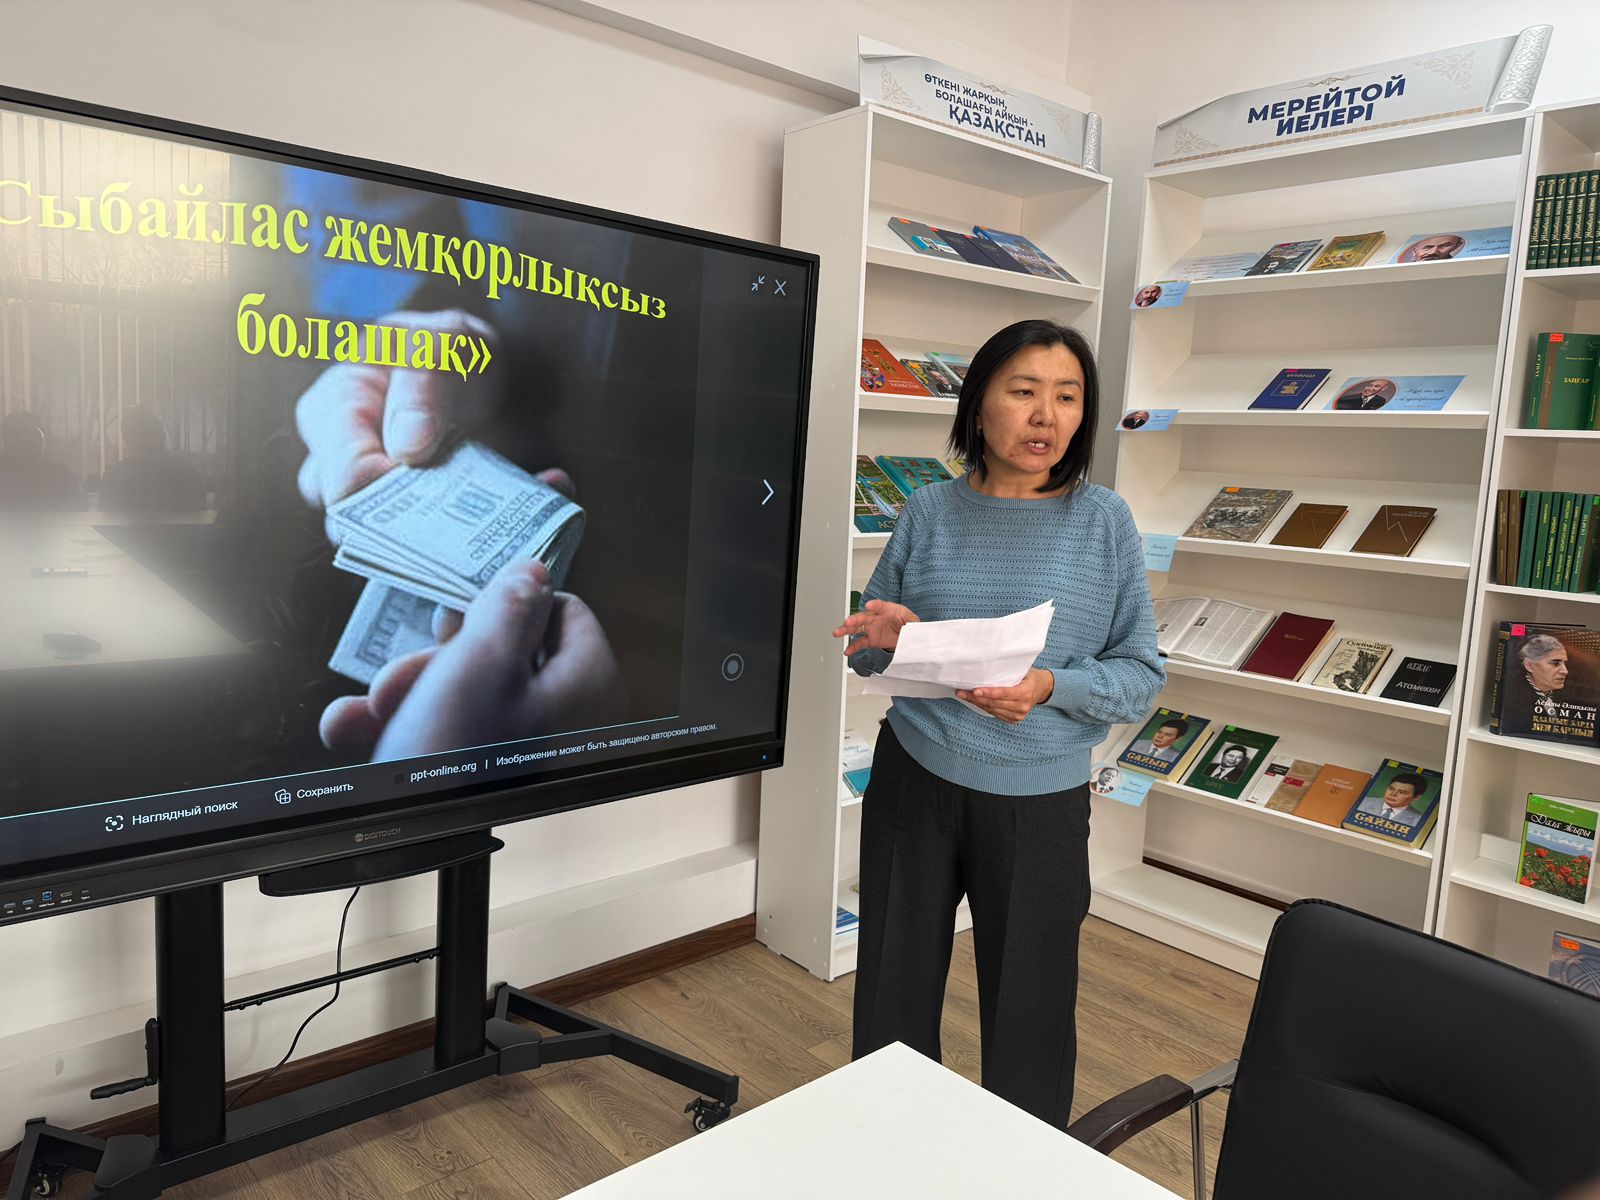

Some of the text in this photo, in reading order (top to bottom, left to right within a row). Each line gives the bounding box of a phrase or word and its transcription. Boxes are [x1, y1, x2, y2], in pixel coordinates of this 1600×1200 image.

[924, 73, 1008, 110] ӨТКЕНІ ЖАРҚЫН,
[935, 89, 993, 117] БОЛАШАҒЫ
[995, 107, 1028, 127] АЙҚЫН
[1247, 74, 1406, 124] МЕРЕЙТОЙ
[949, 104, 1046, 149] ҚАЗАҚСТАН
[1275, 103, 1374, 137] ИЕЛЕРІ
[0, 180, 668, 320] Сыбайлас жемқорлықсыз
[235, 293, 493, 382] болашақ»
[1534, 706, 1596, 721] ОСМАН
[410, 723, 718, 782] ppt-online.org Изображение может быть защищено авторским правом.
[296, 783, 354, 799] Сохранить
[132, 800, 239, 826] Наглядный поиск
